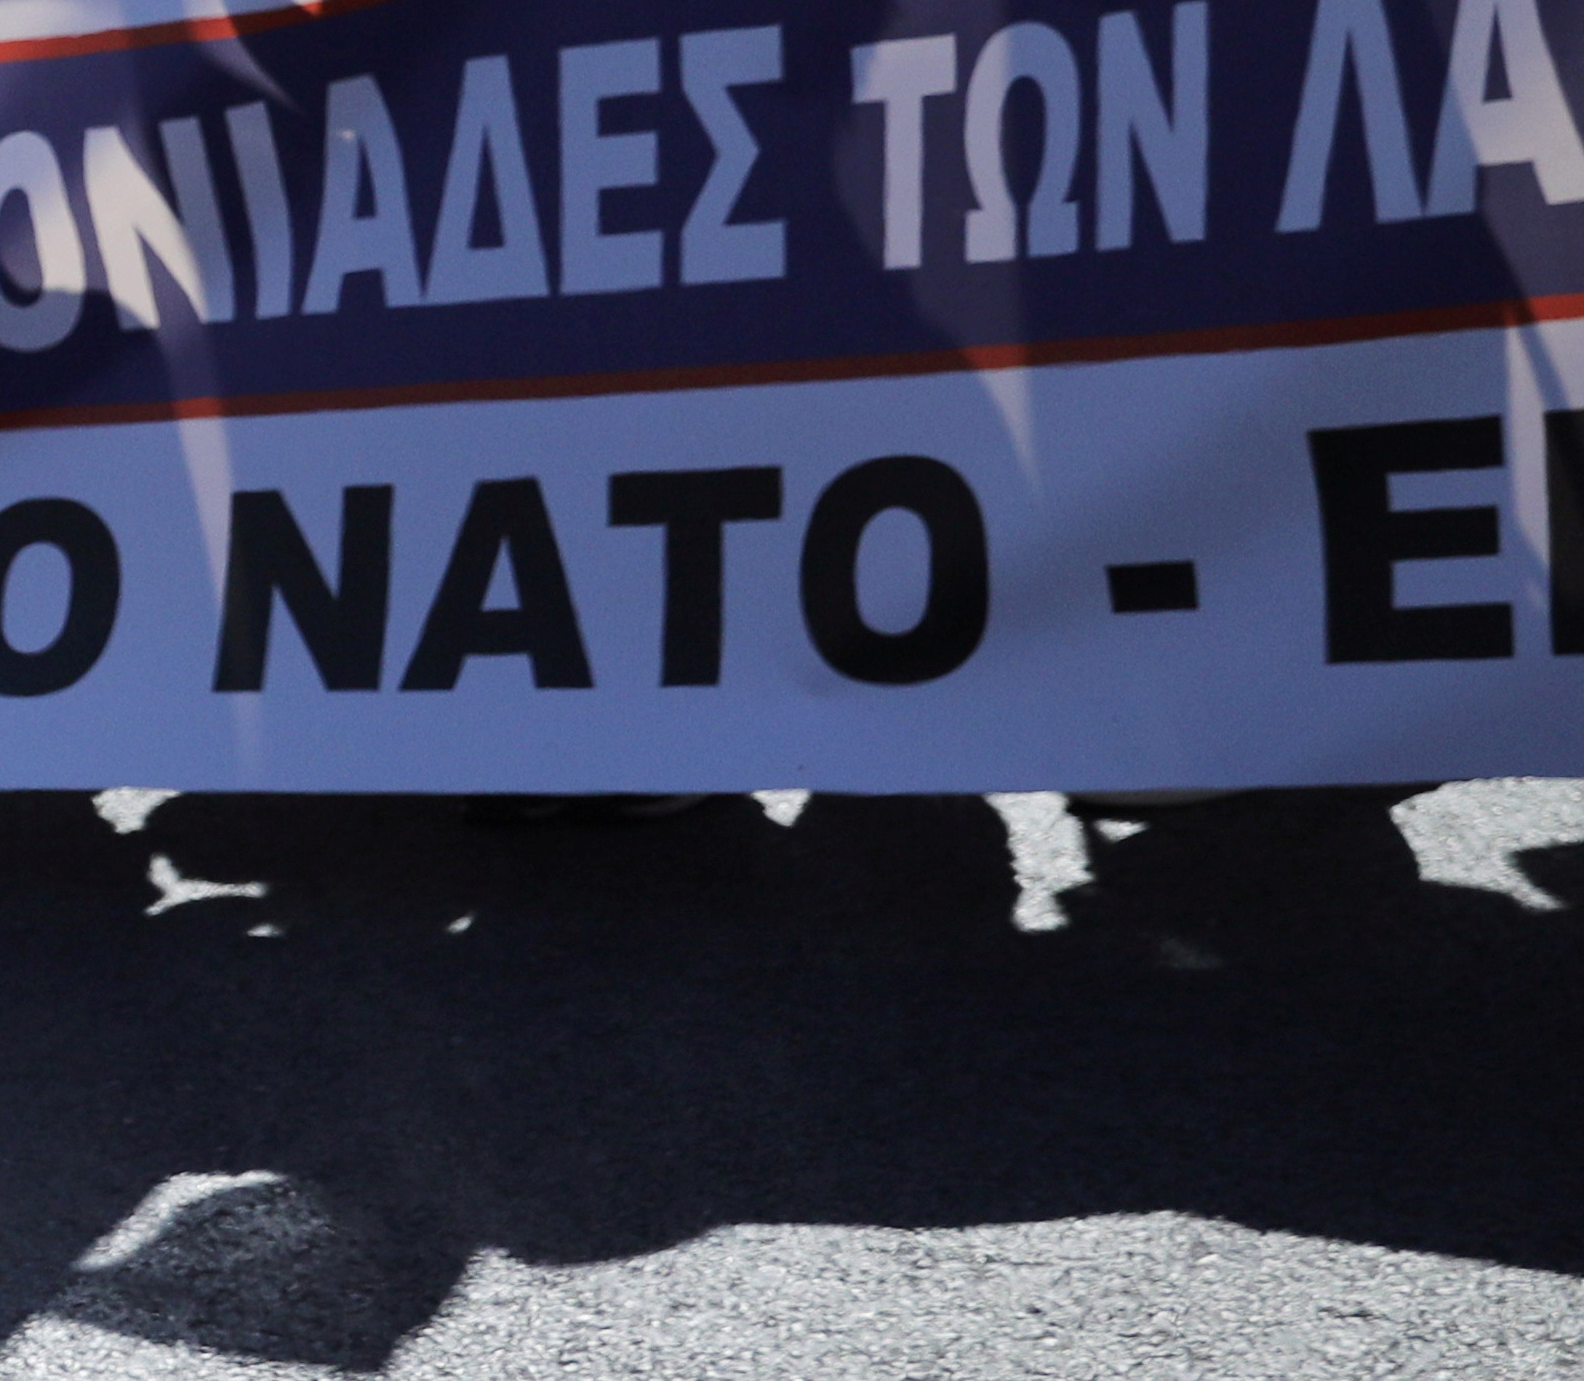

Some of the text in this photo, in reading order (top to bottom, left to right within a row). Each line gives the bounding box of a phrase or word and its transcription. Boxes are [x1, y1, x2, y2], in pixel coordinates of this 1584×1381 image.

[851, 0, 1210, 272] ΤΩΝ
[212, 452, 990, 694] ΝΑΤΟ
[1307, 406, 1584, 665] Ε
